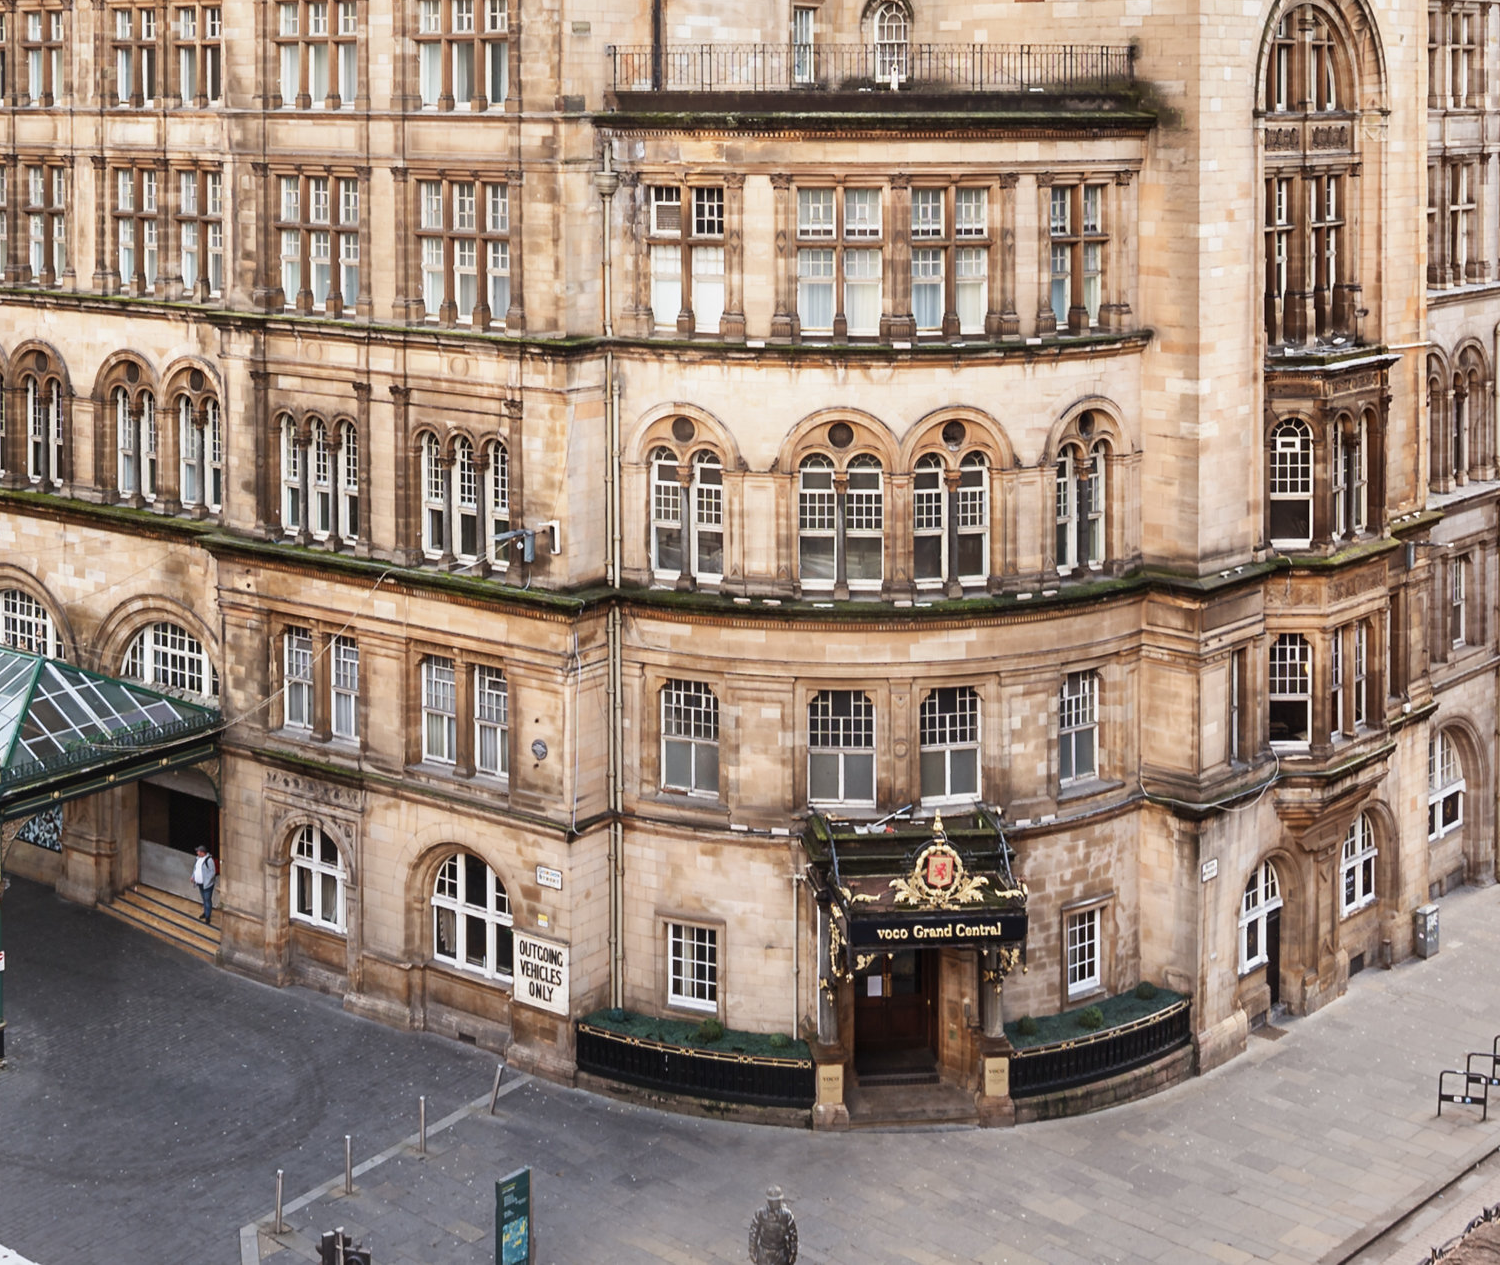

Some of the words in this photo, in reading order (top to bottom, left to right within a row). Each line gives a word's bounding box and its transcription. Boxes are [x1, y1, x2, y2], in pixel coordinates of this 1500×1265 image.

[877, 928, 909, 940] voco
[913, 924, 953, 939] Grand
[955, 922, 1002, 937] Central
[520, 940, 563, 967] OUTGOING
[520, 958, 562, 986] VEHICLES
[529, 981, 554, 1003] ONLY
